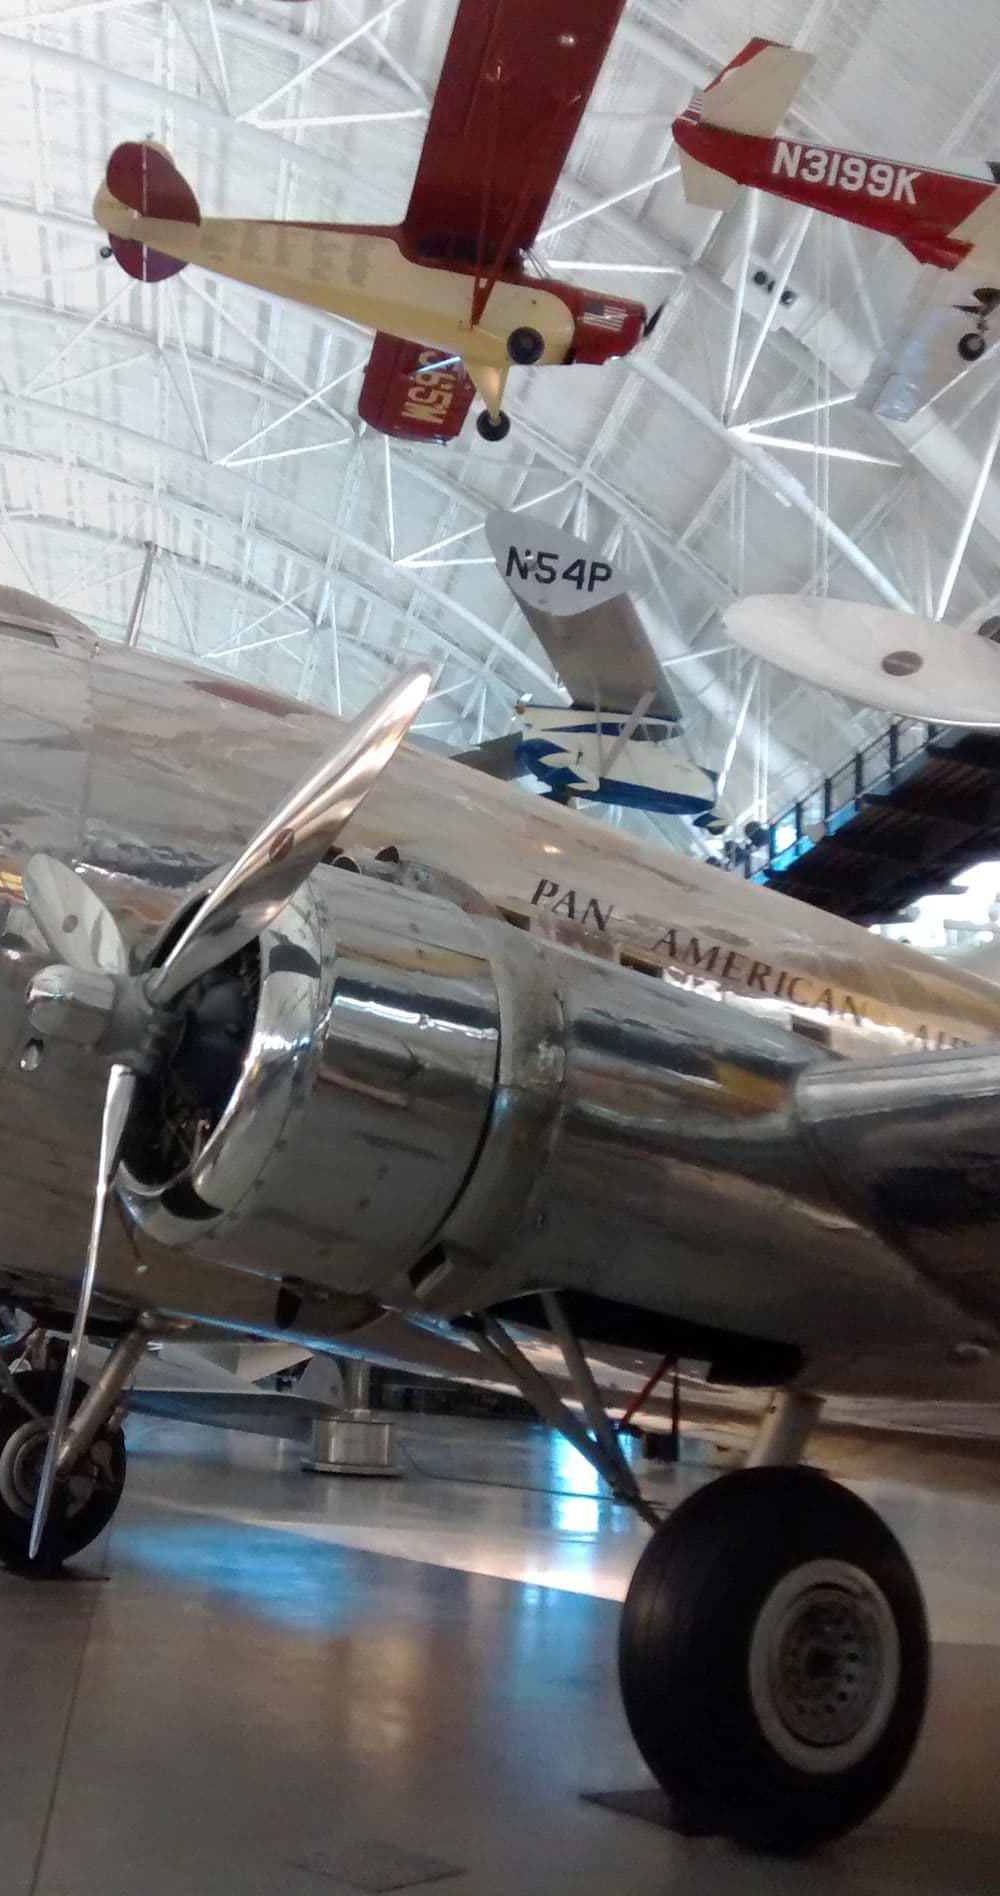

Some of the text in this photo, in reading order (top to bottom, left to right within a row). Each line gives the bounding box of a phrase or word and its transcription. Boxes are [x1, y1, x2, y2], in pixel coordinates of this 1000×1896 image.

[772, 142, 921, 204] N3199K
[505, 545, 612, 592] N54P
[530, 878, 614, 932] PAN
[651, 927, 869, 1027] AMERICAN
